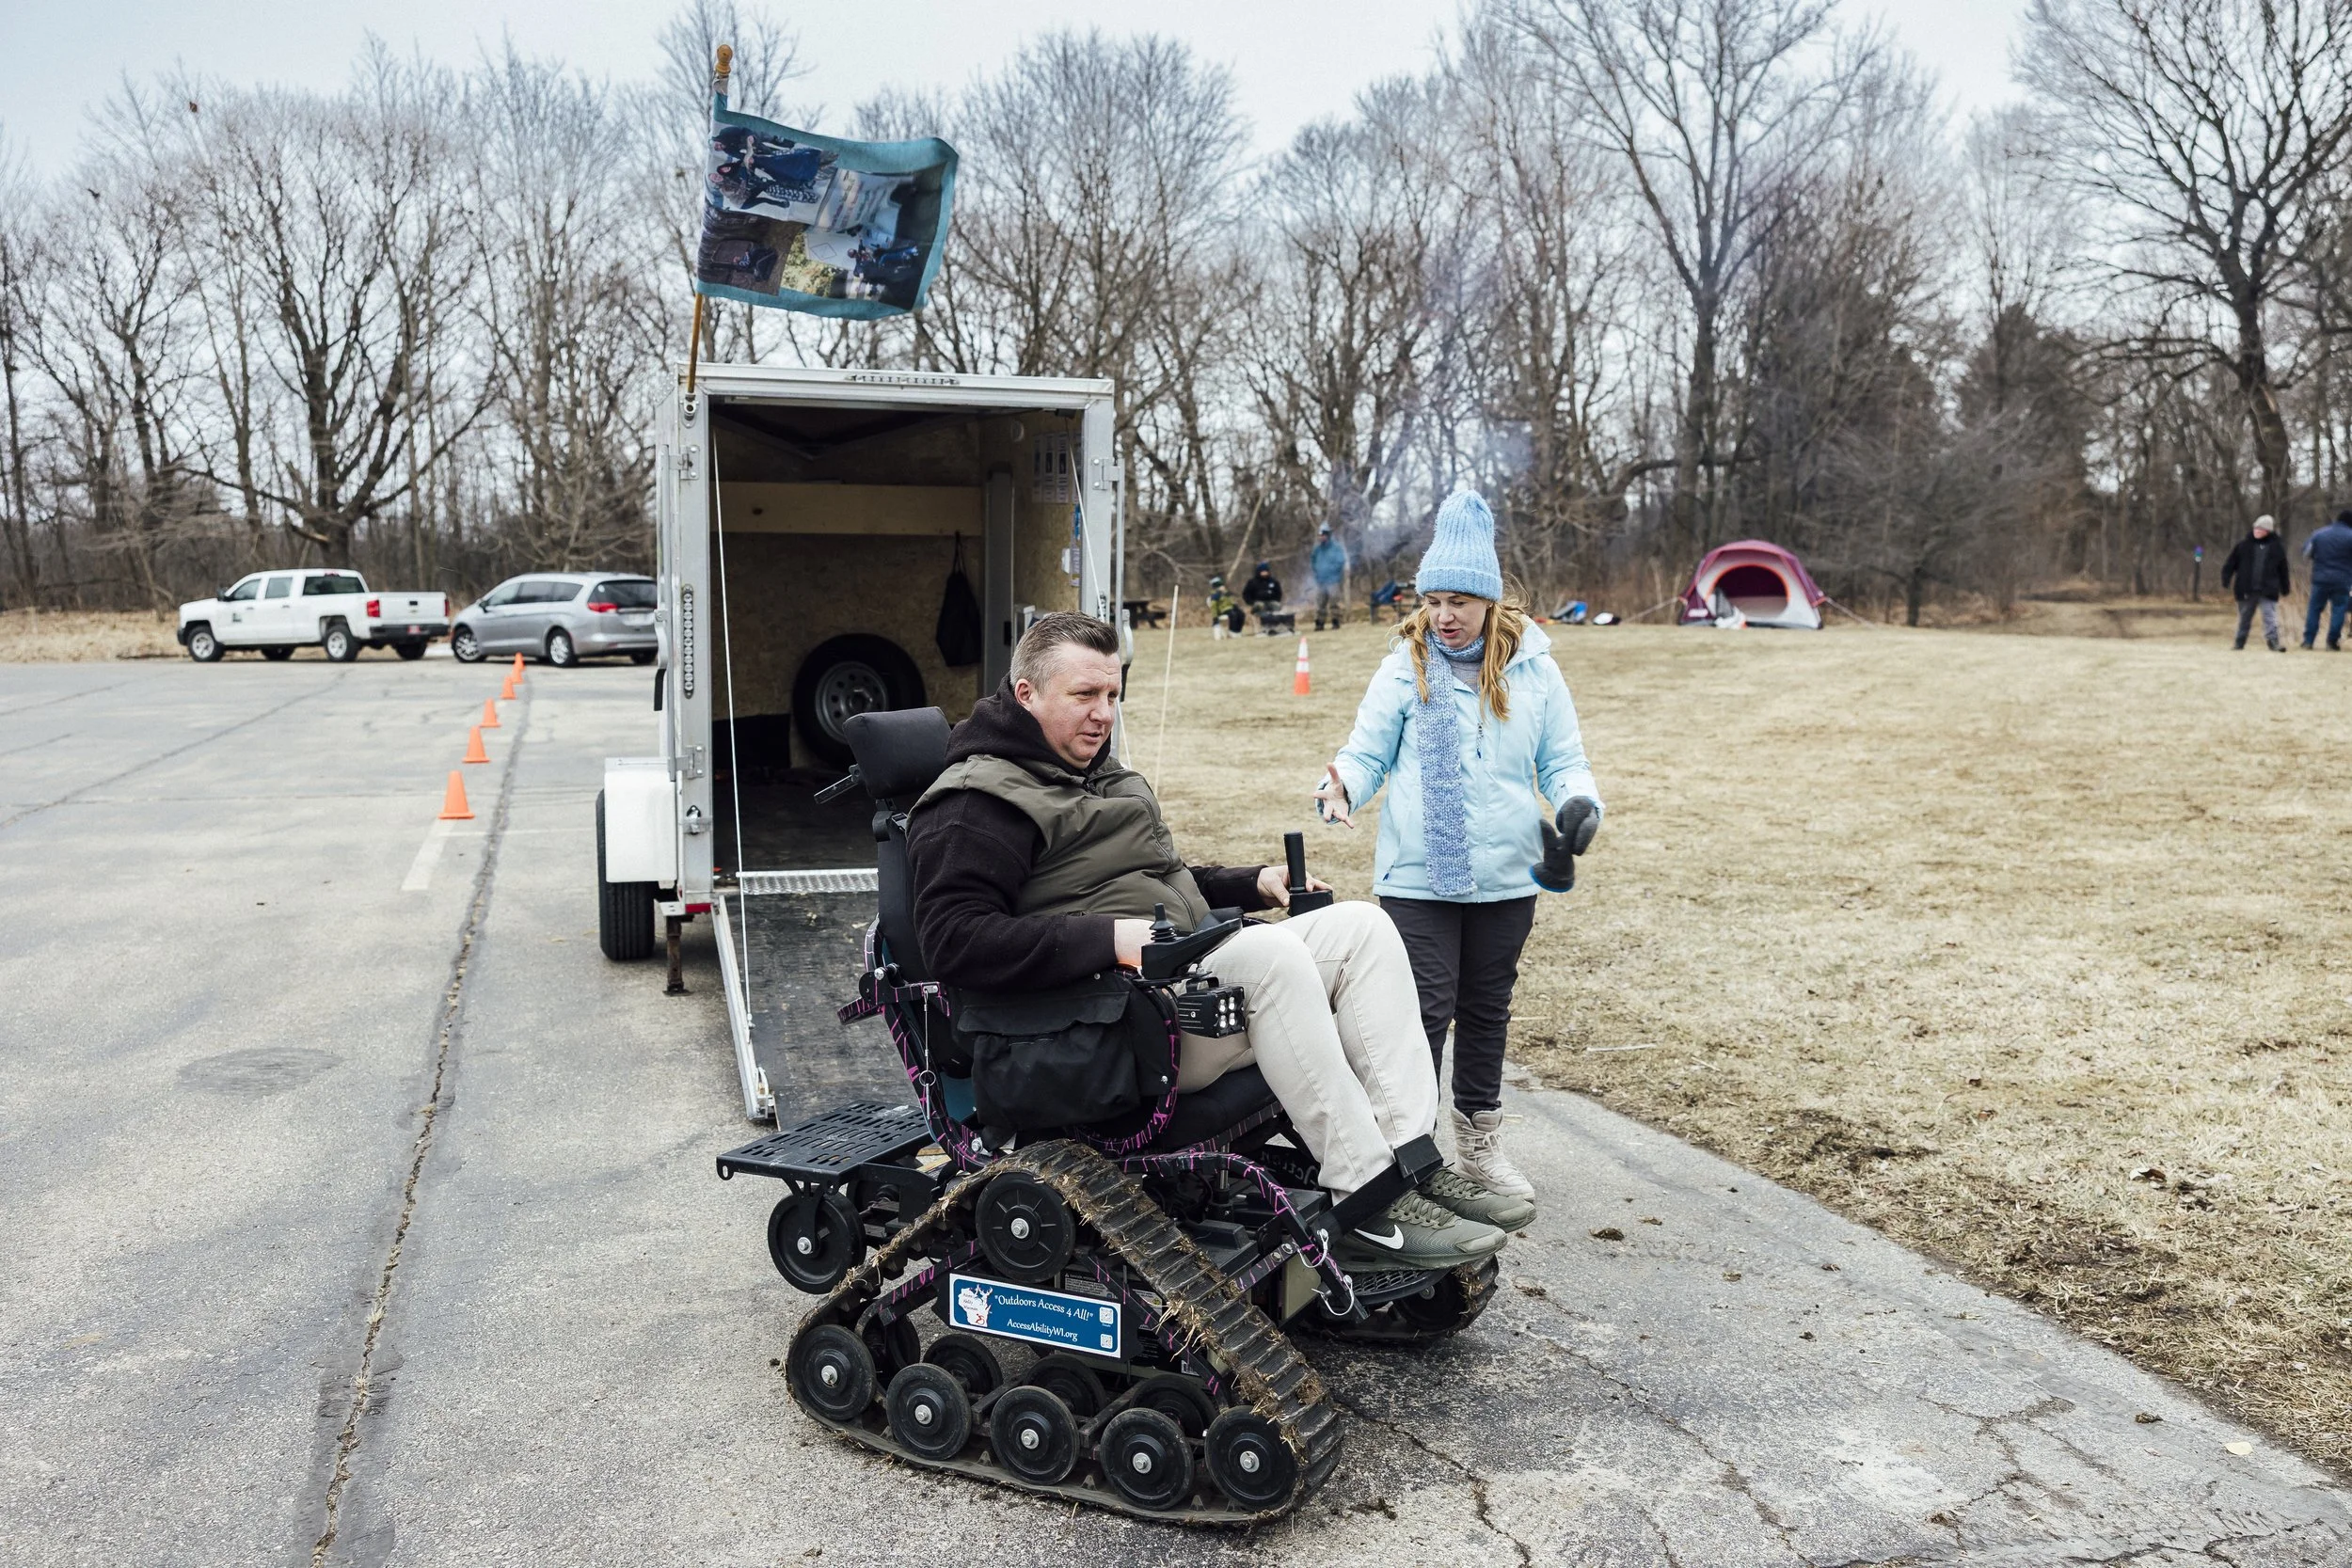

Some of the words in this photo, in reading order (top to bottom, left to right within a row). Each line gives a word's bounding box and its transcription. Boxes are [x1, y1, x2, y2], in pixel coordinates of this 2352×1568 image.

[1038, 1298, 1065, 1313] Access
[1066, 1307, 1072, 1318] 4
[1007, 1318, 1078, 1342] AccessAbilityWI.org
